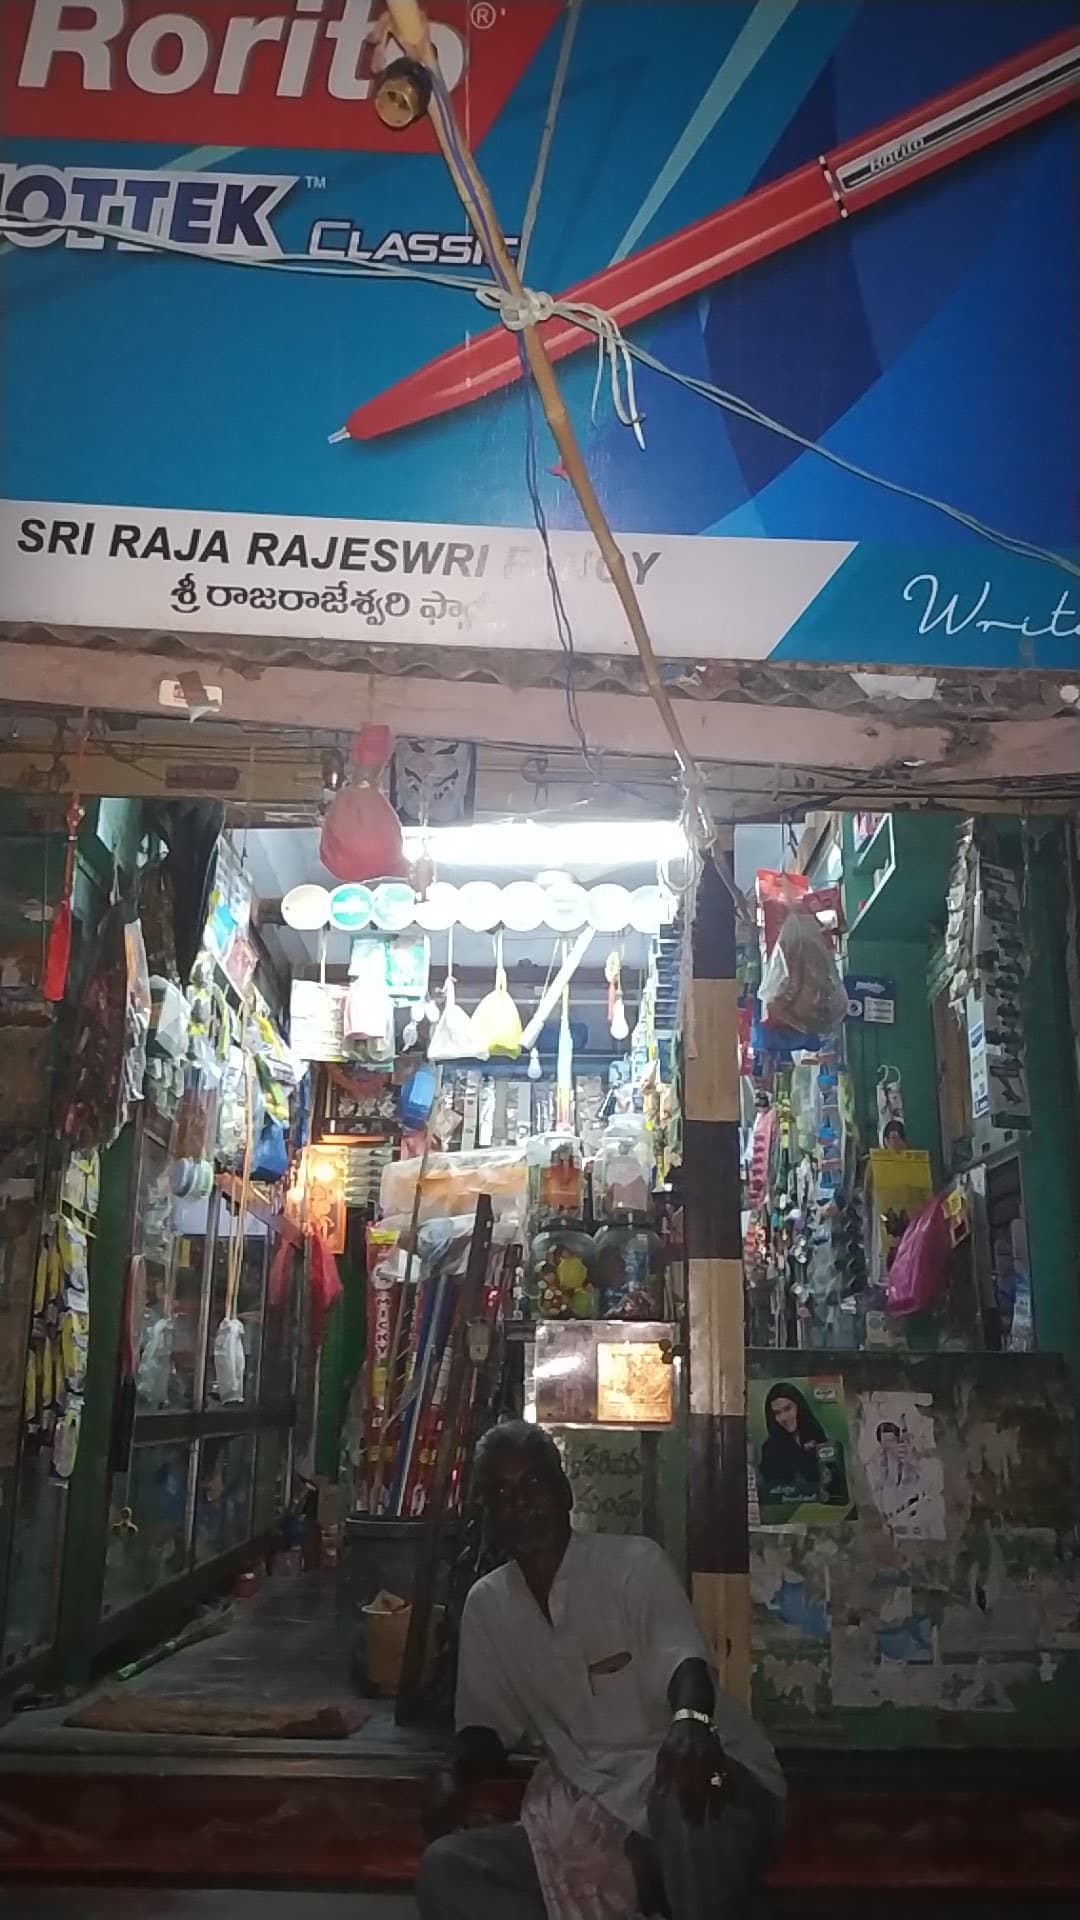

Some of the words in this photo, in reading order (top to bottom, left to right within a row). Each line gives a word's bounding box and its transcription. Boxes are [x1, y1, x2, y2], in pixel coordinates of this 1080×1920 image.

[0, 173, 277, 247] OTTEK
[309, 219, 521, 265] CLASSI
[17, 519, 95, 556] SRI
[109, 524, 230, 564] RAJA
[246, 532, 490, 578] RAJESWRI
[170, 572, 201, 613] శ్రీ
[903, 574, 1080, 637] Writ
